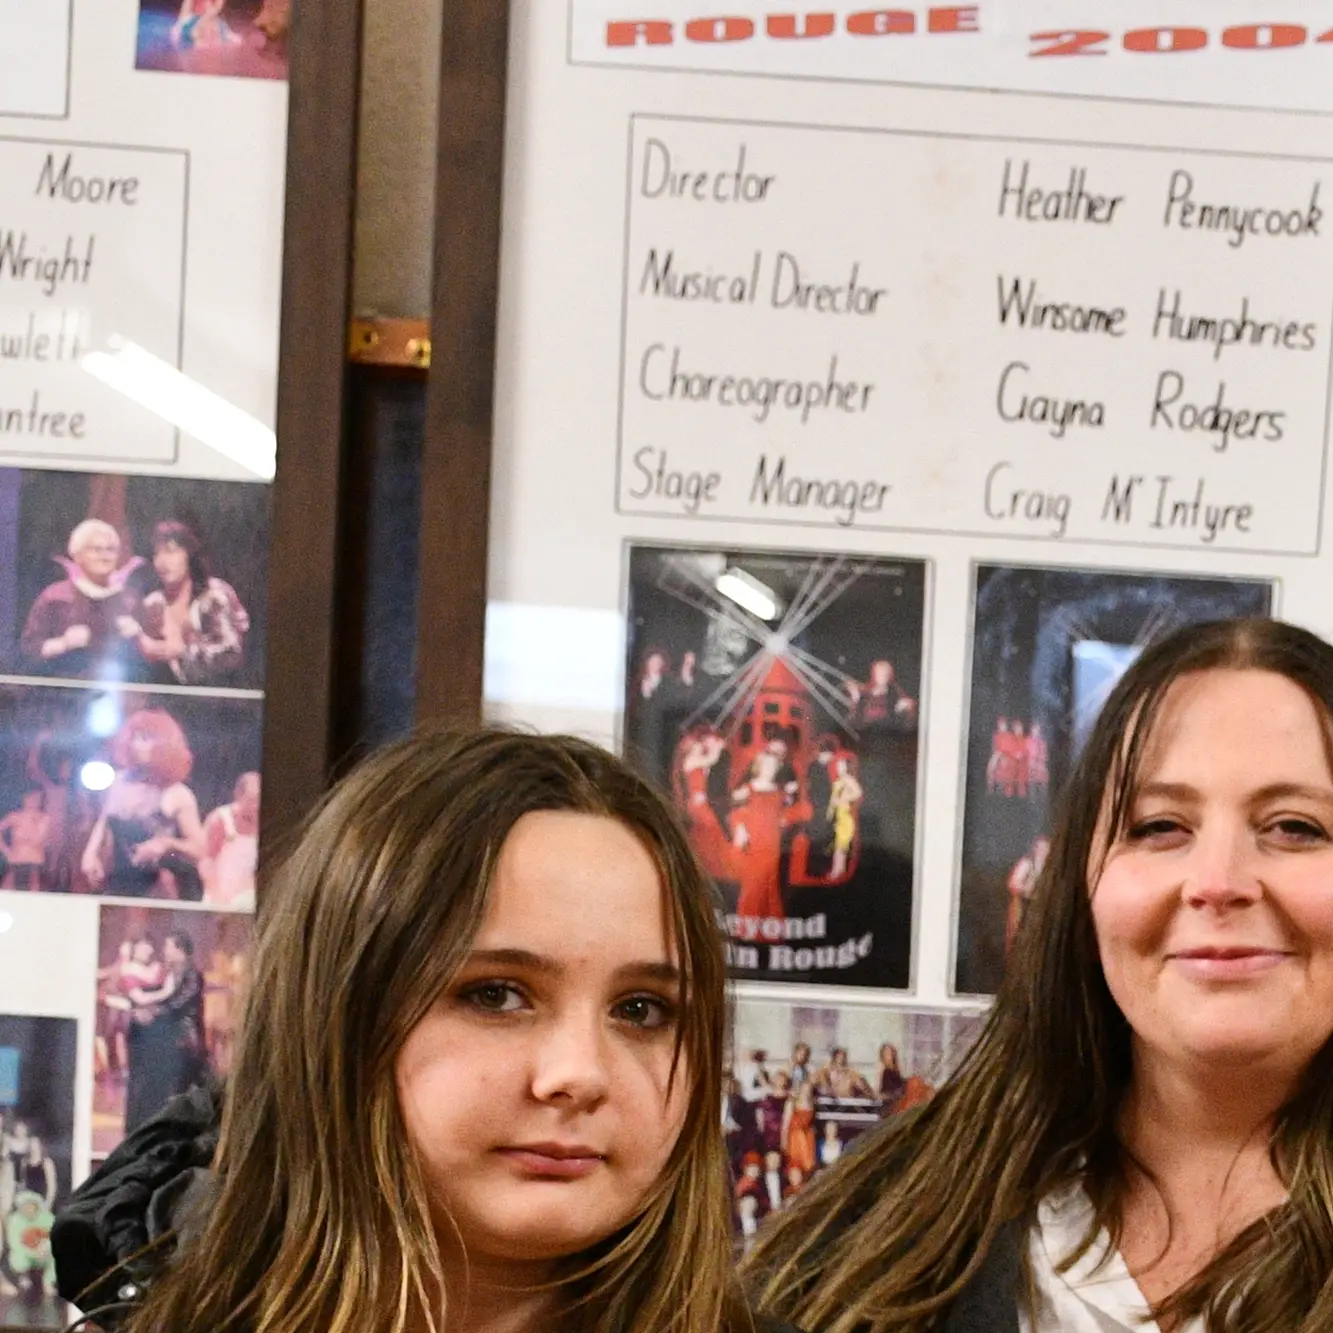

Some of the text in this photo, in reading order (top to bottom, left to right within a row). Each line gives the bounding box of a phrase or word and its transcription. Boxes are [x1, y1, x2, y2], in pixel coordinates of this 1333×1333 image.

[606, 5, 980, 48] ROUGE
[35, 152, 140, 206] Moore
[641, 137, 776, 203] Director
[997, 159, 1324, 248] Heather Pennycook
[638, 248, 888, 316] Musical Director
[997, 275, 1317, 361] Winsome Humphries
[638, 342, 875, 425] Choreographer
[996, 360, 1286, 453] Gayna Rodgers
[628, 445, 892, 526] Stage Manager
[983, 460, 1070, 539] Craig
